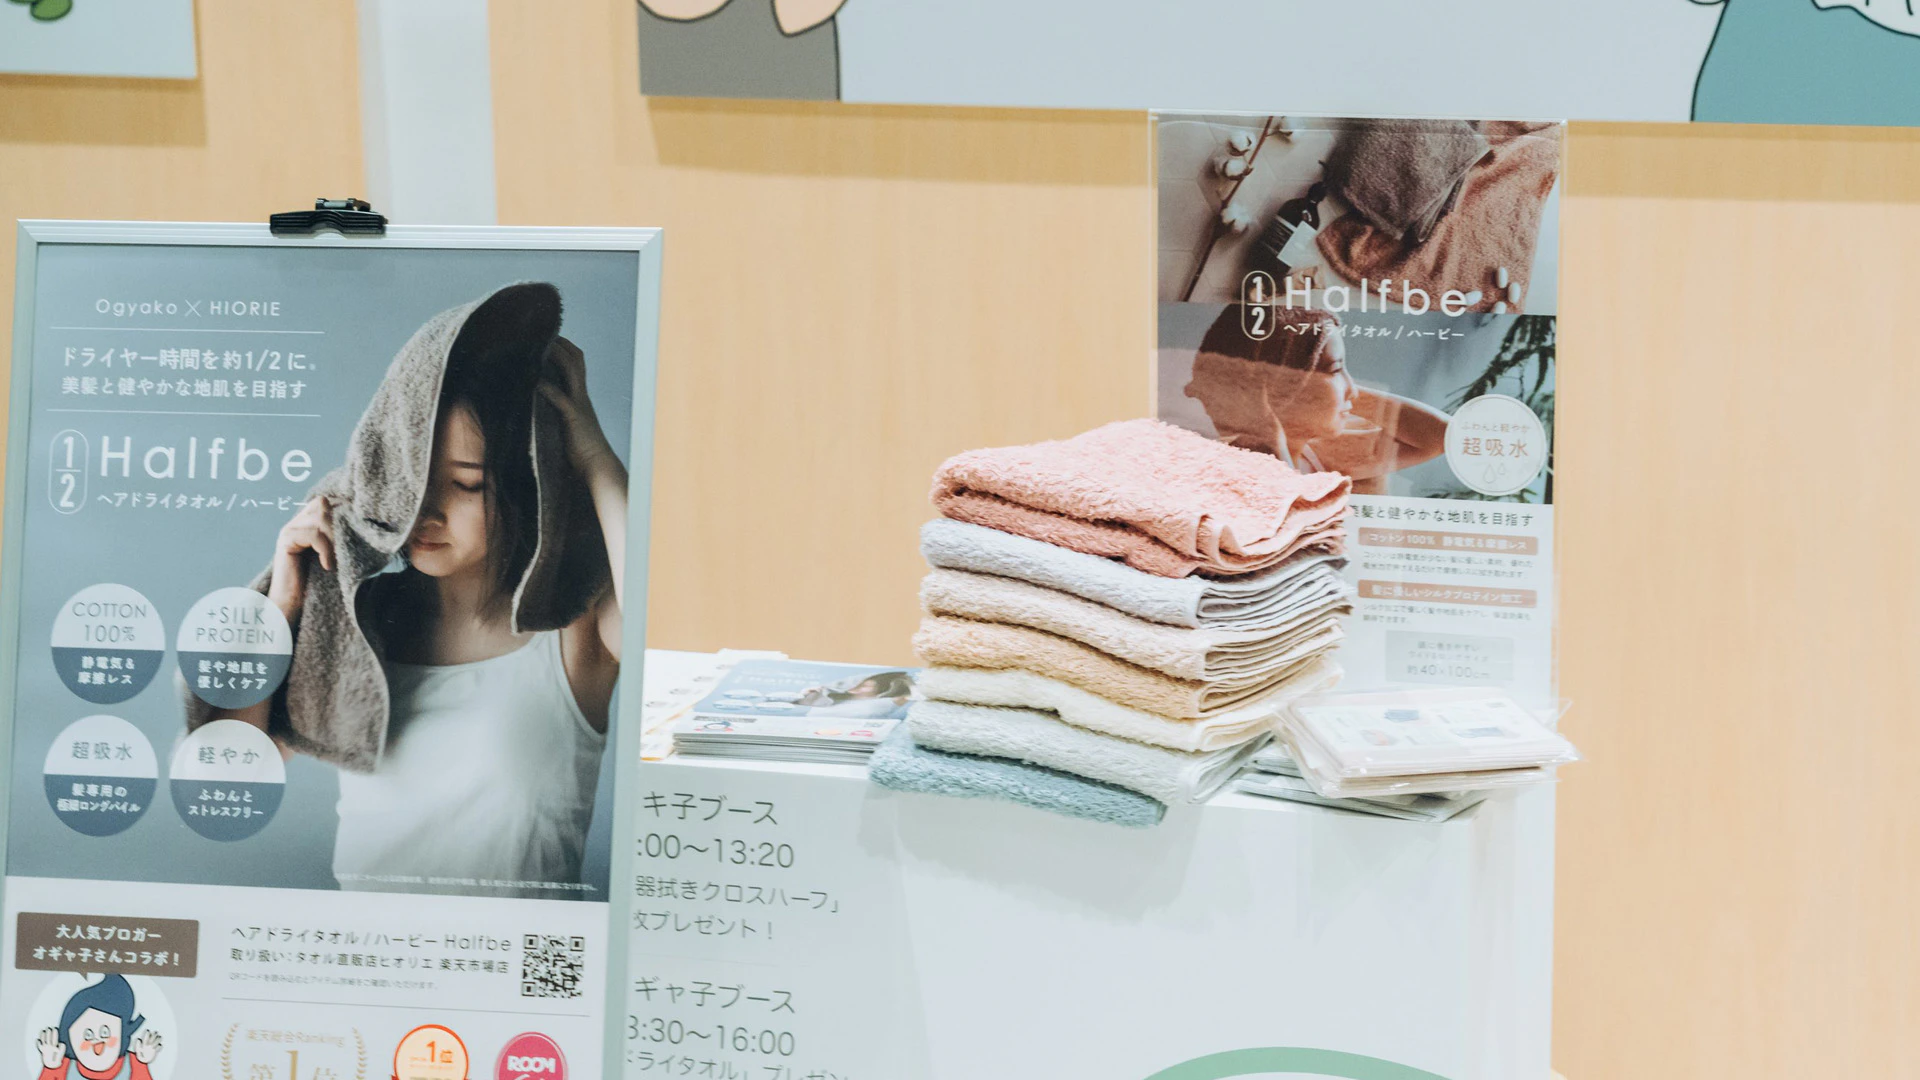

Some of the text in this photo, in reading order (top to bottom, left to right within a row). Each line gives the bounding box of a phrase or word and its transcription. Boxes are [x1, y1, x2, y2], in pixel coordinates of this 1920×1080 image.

[1286, 276, 1467, 317] Halfbe
[95, 299, 178, 316] Ogyako
[209, 301, 281, 316] HIORIE
[61, 376, 307, 399] 美髪と健やかな地肌を目指す
[1462, 437, 1529, 458] 超吸水
[100, 435, 312, 482] Halfbe
[72, 601, 147, 619] COTTON
[207, 606, 265, 625] +SILK
[84, 625, 136, 643] 100%
[196, 627, 274, 645] PROTEIN
[72, 741, 132, 761] 超吸水
[198, 746, 260, 765] 軽やか
[643, 791, 778, 825] キ子ブース
[56, 924, 162, 942] 大人気ブロガー
[444, 934, 512, 952] Halfbe
[635, 976, 796, 1014] ギャ子ブース
